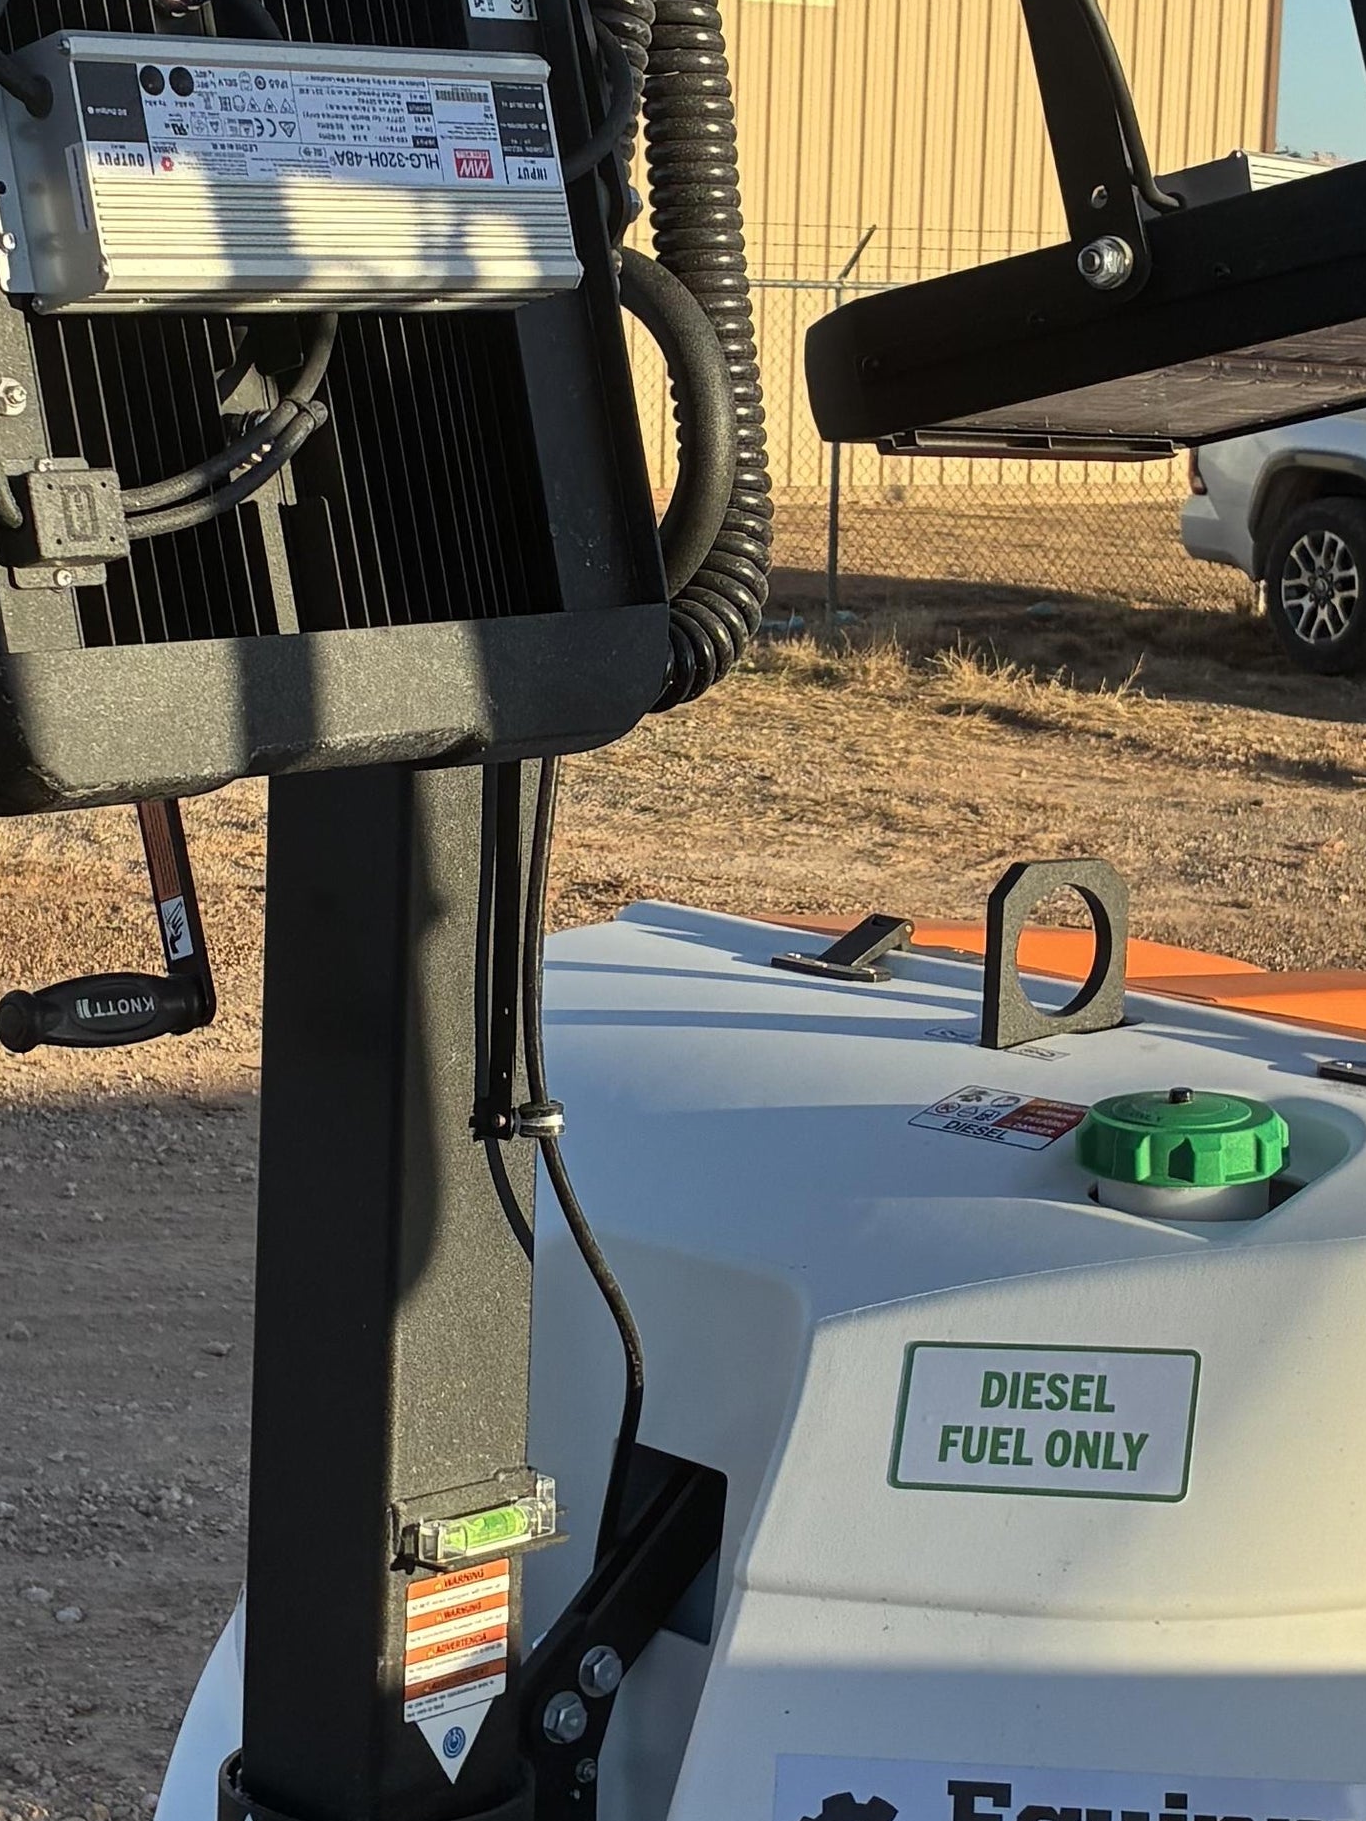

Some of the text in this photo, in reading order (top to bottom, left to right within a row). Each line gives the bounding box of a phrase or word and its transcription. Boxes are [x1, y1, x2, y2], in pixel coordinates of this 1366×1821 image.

[95, 151, 145, 166] OUTPUT
[334, 149, 440, 169] HLG-320H-48A
[515, 166, 547, 180] INPUT
[93, 996, 155, 1018] KNOTT
[941, 1119, 1007, 1142] DIESEL
[979, 1371, 1116, 1414] DIESEL
[937, 1424, 1150, 1472] FUEL ONLY
[443, 1568, 484, 1589] WARNING
[443, 1601, 482, 1619] WARNING
